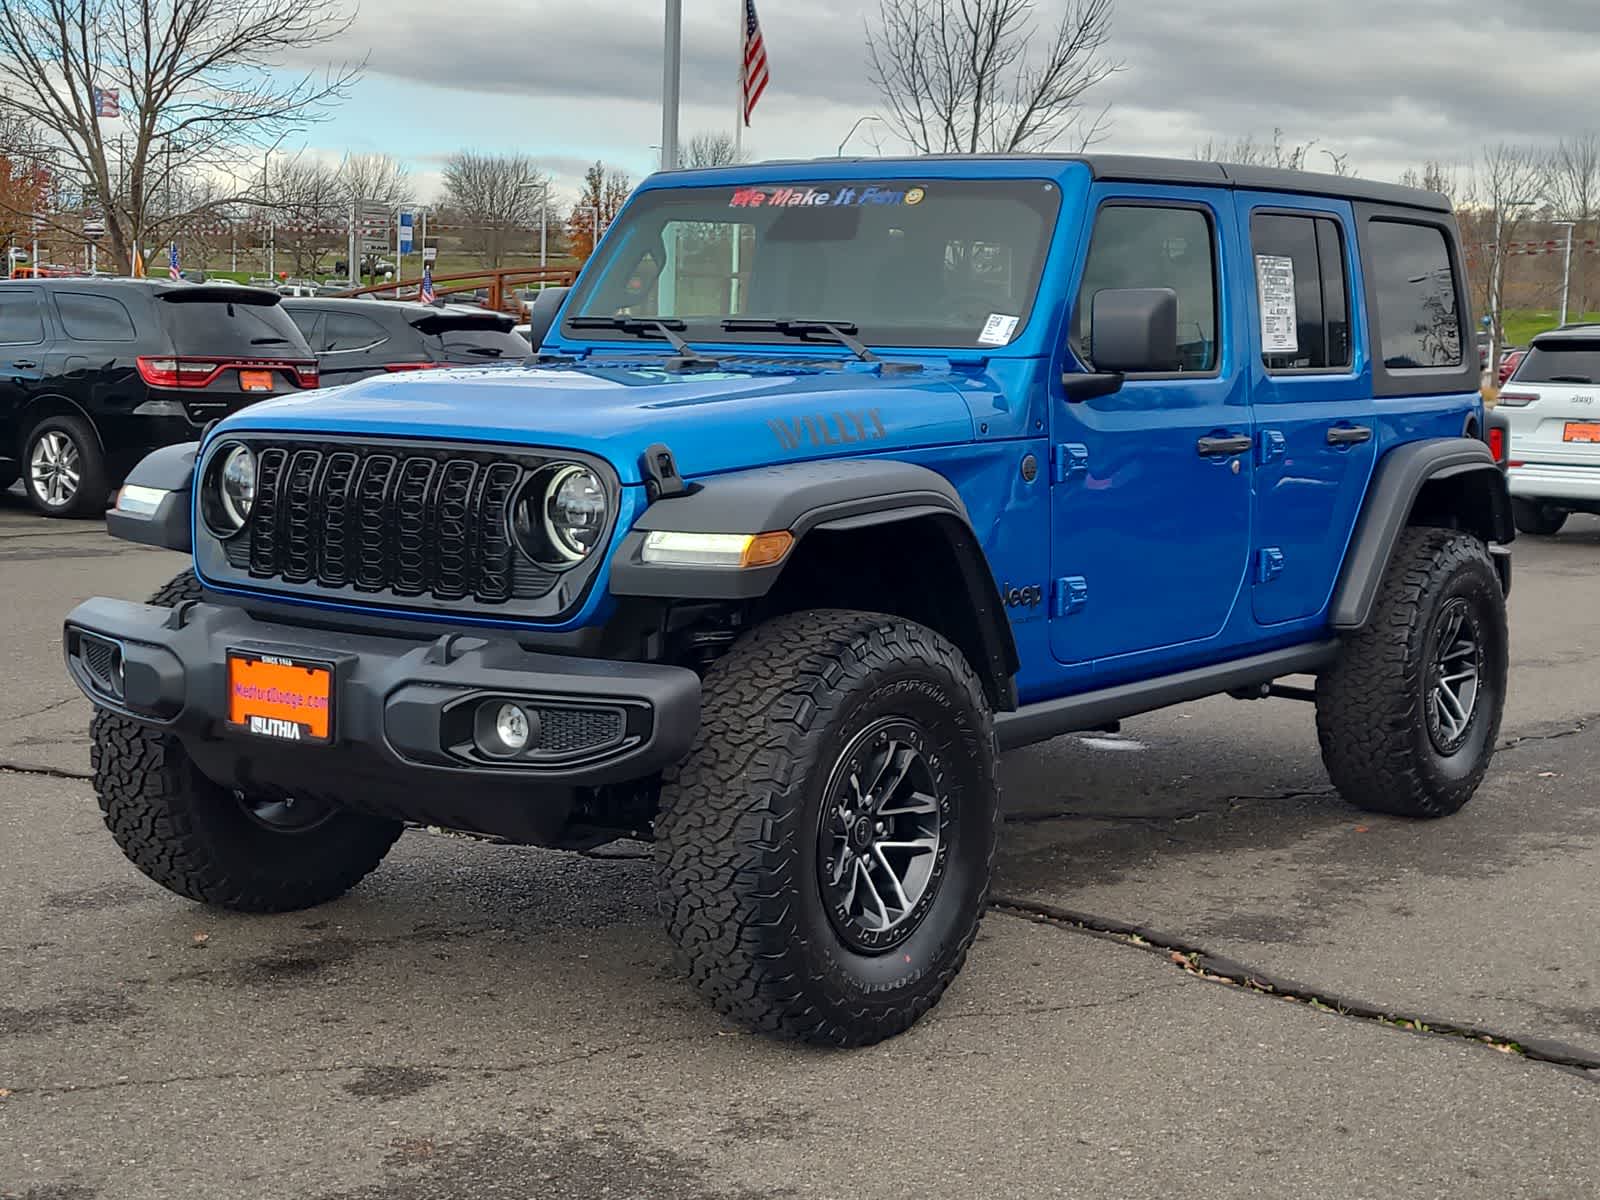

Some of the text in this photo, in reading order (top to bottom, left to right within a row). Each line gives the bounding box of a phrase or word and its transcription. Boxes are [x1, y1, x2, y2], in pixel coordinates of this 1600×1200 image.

[769, 187, 830, 206] Make
[834, 187, 856, 206] It
[1001, 582, 1041, 608] Jeep
[263, 718, 300, 740] LITHIA
